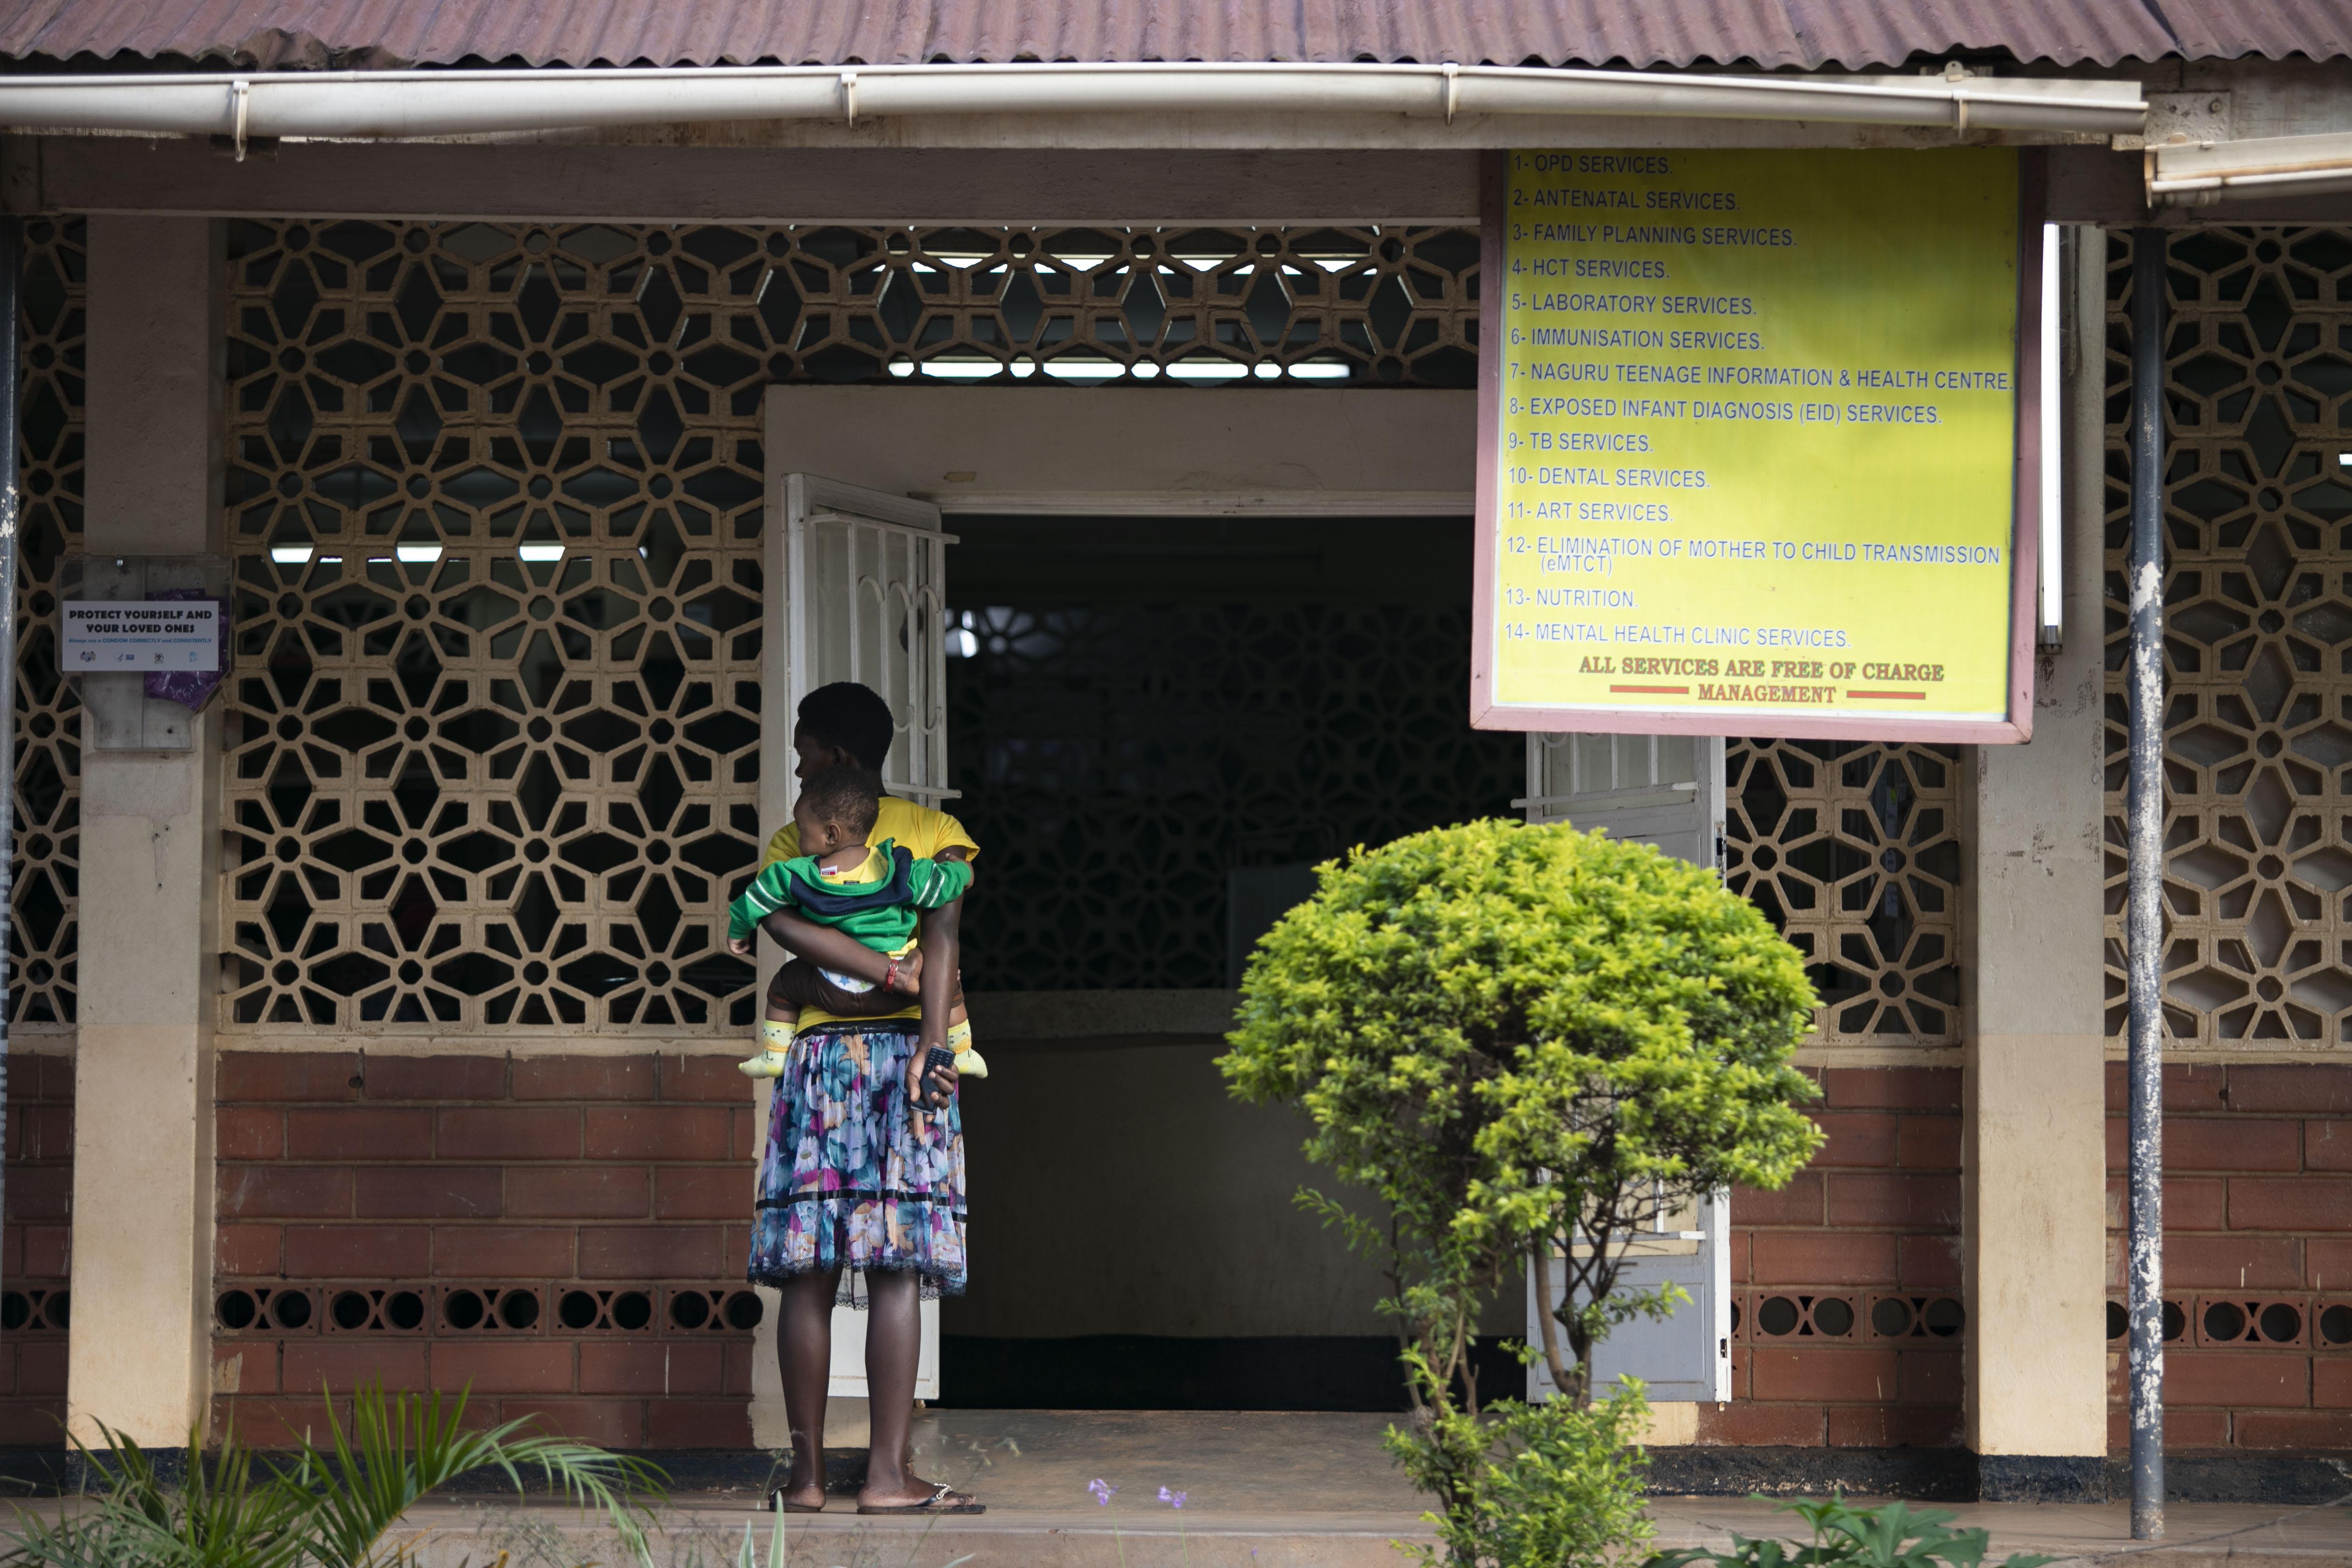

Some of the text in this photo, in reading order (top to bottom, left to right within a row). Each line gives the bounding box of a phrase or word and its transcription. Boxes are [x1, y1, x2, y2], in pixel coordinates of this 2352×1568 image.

[1515, 154, 1673, 174] 1- OPD SERVICES.
[1513, 189, 1740, 210] 2- ANTENATAL SERVICES.
[1513, 224, 1797, 246] 3- FAMILY PLANNING SERVICES.
[1512, 259, 1669, 278] 4- HCT SERVICES.
[1512, 294, 1756, 315] 5- LABORATORY SERVICES.
[1512, 328, 1764, 350] 6- IMMUNISATION SERVICES.
[1511, 363, 2011, 390] 7- NAGURU TEENAGE INFORMATION & HEALTH CENTRE.
[1510, 398, 1941, 424] 8- EXPOSED INFANT DIAGNOSIS (EID) SERVICES.
[1509, 433, 1652, 451] 9- TB SERVICES.
[1509, 467, 1709, 487] 10- DENTAL SERVICES.
[1508, 502, 1673, 521] 11- ART SERVICES.
[1507, 537, 1999, 563] 12- ELIMINATION OF MOTHER TO CHILD TRANSMISSION
[1542, 554, 1612, 575] (eMTCT)
[1506, 588, 1638, 607] 13- NUTRITION.
[70, 610, 212, 619] PROTECT YOURSELF AND
[86, 624, 194, 633] YOUR LOVED ONES
[1505, 623, 1850, 647] 14- MENTAL HEALTH CLINIC SERVICES.
[1580, 657, 1944, 682] ALL SERVICES ARE FREE OF CHARGE
[1699, 683, 1836, 703] MANAGEMENT
